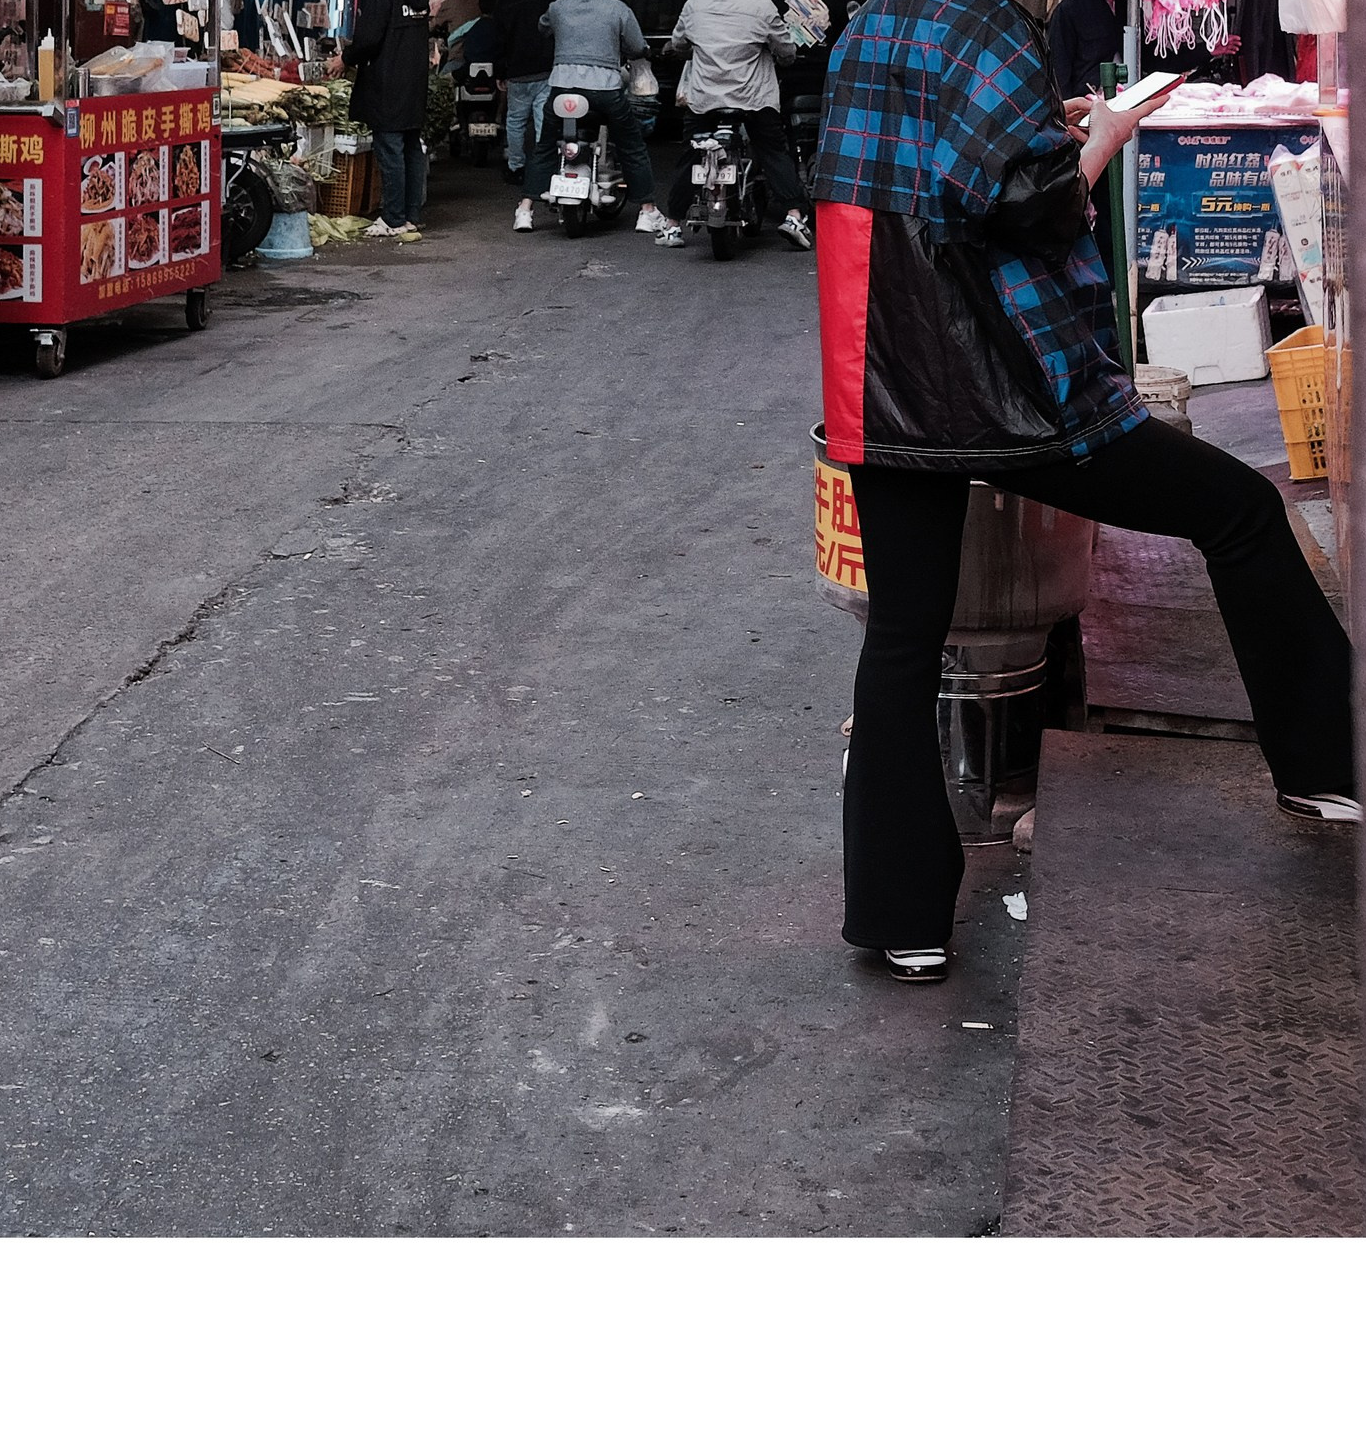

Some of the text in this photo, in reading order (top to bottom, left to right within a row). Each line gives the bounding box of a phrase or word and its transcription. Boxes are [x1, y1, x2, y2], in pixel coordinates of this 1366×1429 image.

[79, 100, 211, 149] 柳州脆皮手撕鸡
